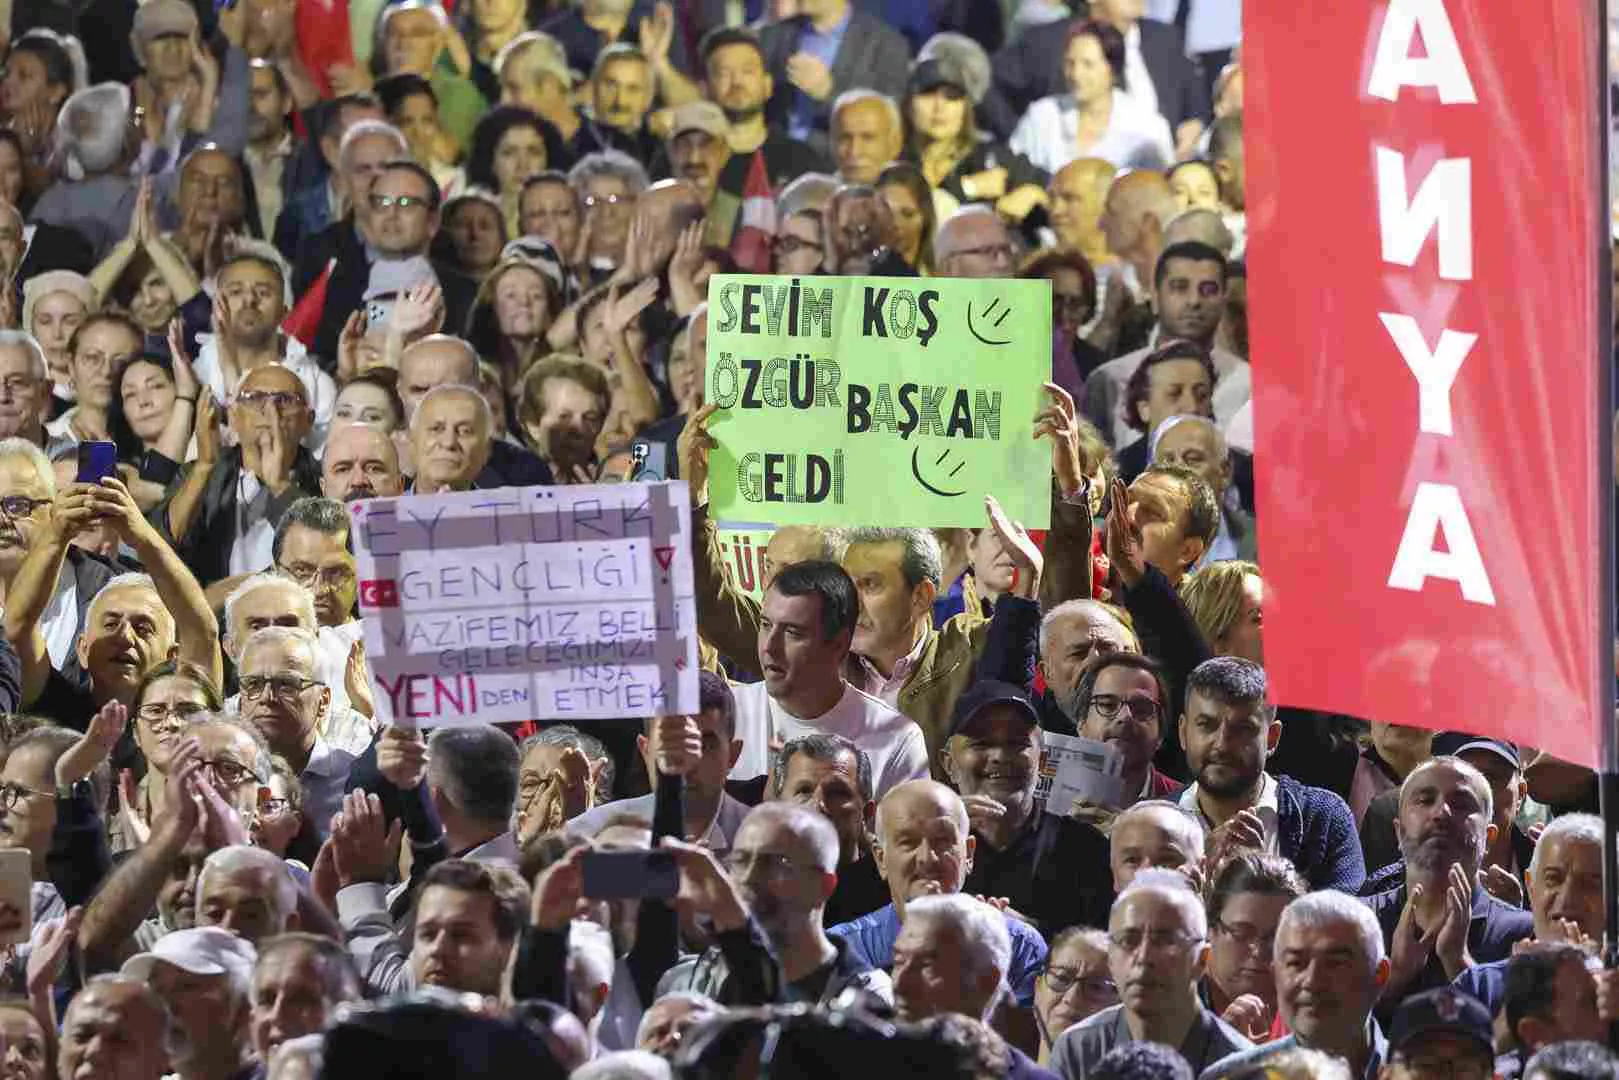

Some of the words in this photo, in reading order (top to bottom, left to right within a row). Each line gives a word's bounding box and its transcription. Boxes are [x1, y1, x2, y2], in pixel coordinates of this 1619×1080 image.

[716, 278, 834, 338] SEVİM
[862, 286, 940, 347] KOŞ
[712, 351, 842, 410] ÖZGÜR
[847, 382, 1002, 441] BAŞKAN
[737, 448, 845, 505] GELDİ
[366, 507, 445, 557] EY
[471, 492, 653, 545] TÜRK
[402, 544, 638, 601] GENÇLİĞİ
[599, 604, 680, 634] BELLİ
[554, 682, 668, 712] ETMEK
